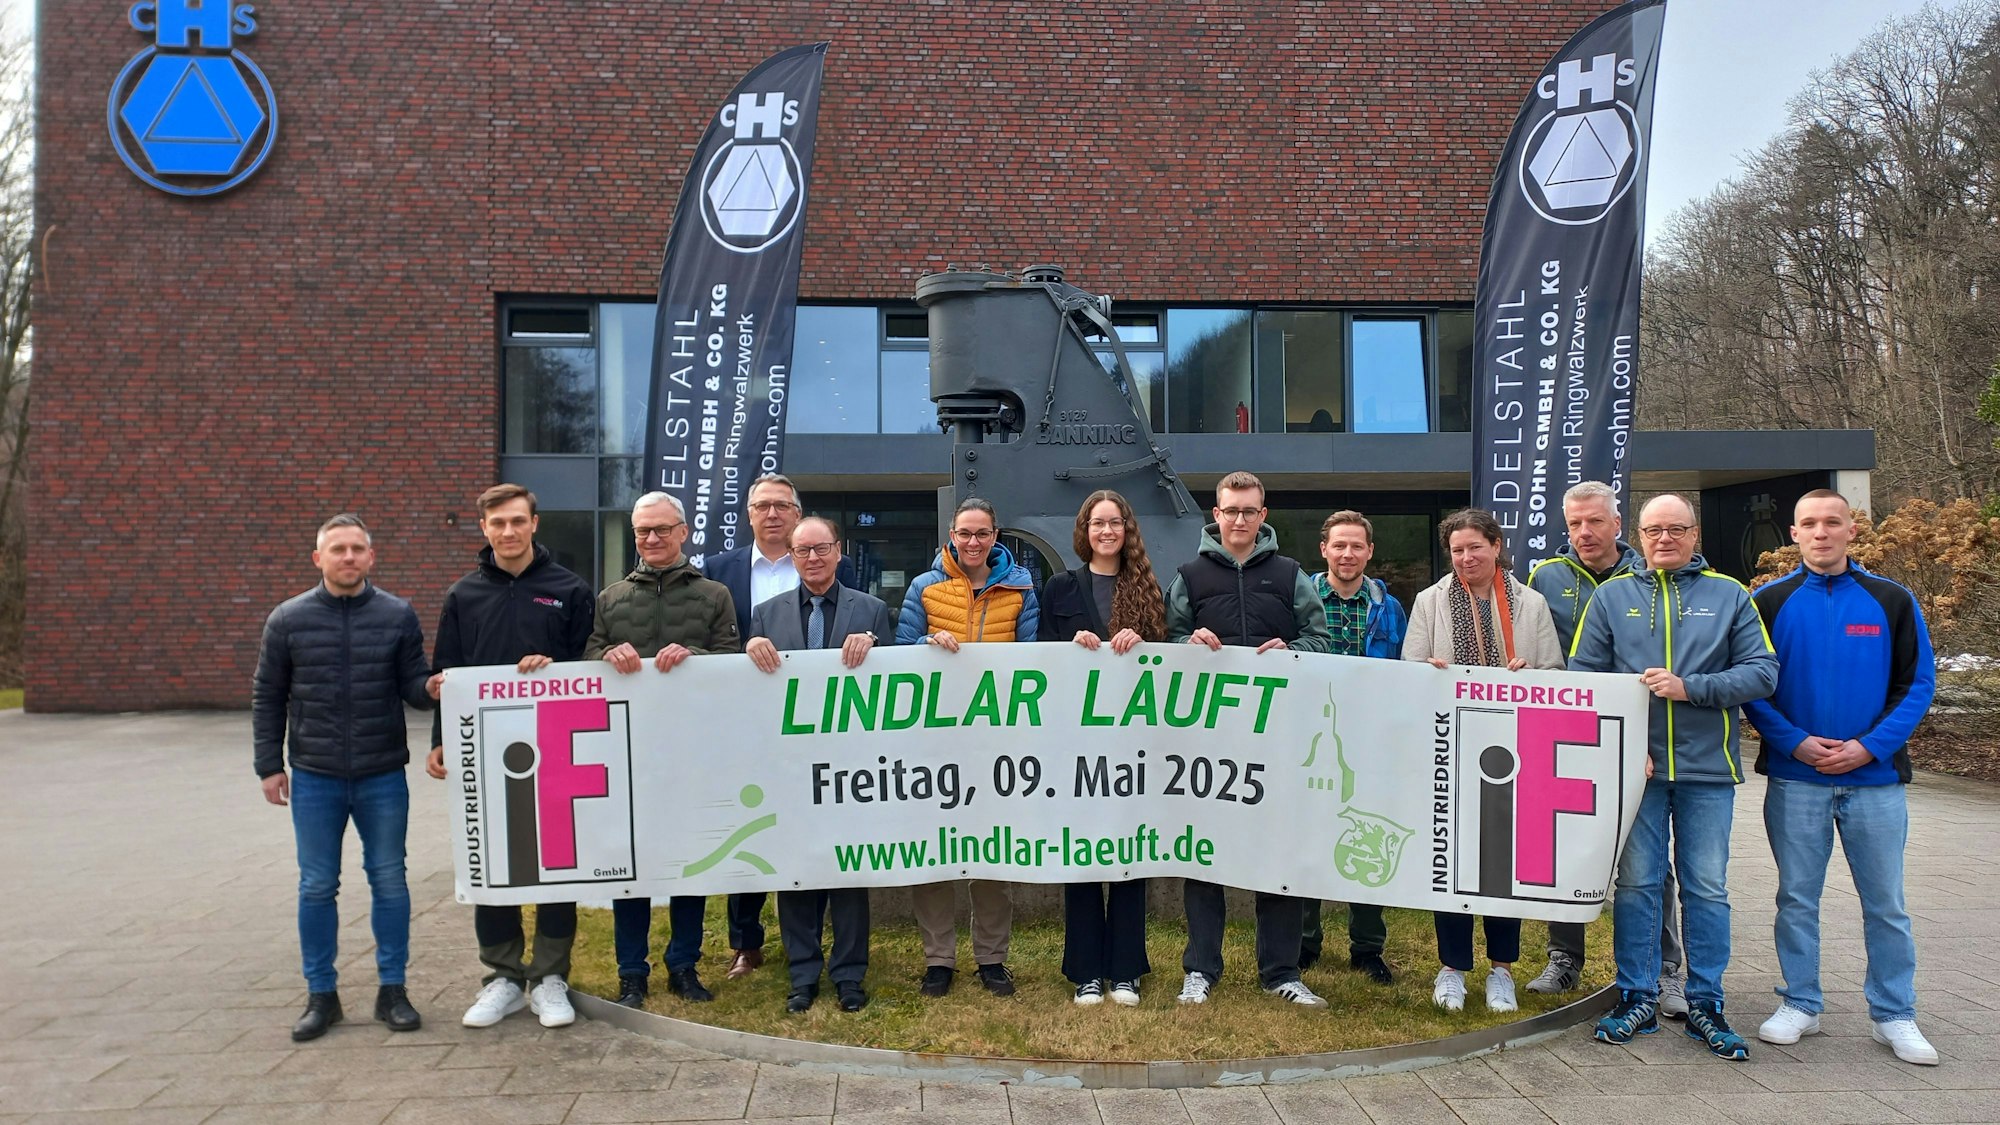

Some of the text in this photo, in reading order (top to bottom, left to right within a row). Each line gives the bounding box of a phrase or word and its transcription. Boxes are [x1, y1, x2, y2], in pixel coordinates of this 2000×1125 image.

[1537, 53, 1636, 110] CHS
[720, 92, 799, 138] CHS
[1541, 259, 1560, 294] KG
[1540, 303, 1559, 347] CO.
[1540, 353, 1557, 370] &
[1563, 286, 1589, 438] Ringwalzwerk
[661, 309, 698, 488] ELSTAHL
[1060, 409, 1088, 422] 3129
[1535, 379, 1555, 450] GMBH
[689, 283, 727, 569] & SOHN GMBH & CO. KG
[719, 313, 753, 554] ede und Ringwalzwerk
[1035, 424, 1136, 445] BANNING
[1562, 444, 1582, 484] und
[1528, 459, 1547, 527] SOHN
[1528, 534, 1546, 550] &
[478, 677, 602, 700] FRIEDRICH
[781, 655, 1289, 735] LINDLAR LÄUFT
[1456, 682, 1594, 707] FRIEDRICH
[459, 714, 482, 888] INDUSTRIEDRUCK
[812, 750, 1265, 809] Freitag, 09. Mai 2025
[1432, 711, 1450, 893] INDUSTRIEDRUCK
[834, 824, 1215, 872] www.lindlar-laeuft.de
[593, 867, 627, 877] GmbH
[1574, 889, 1605, 899] GmbH
